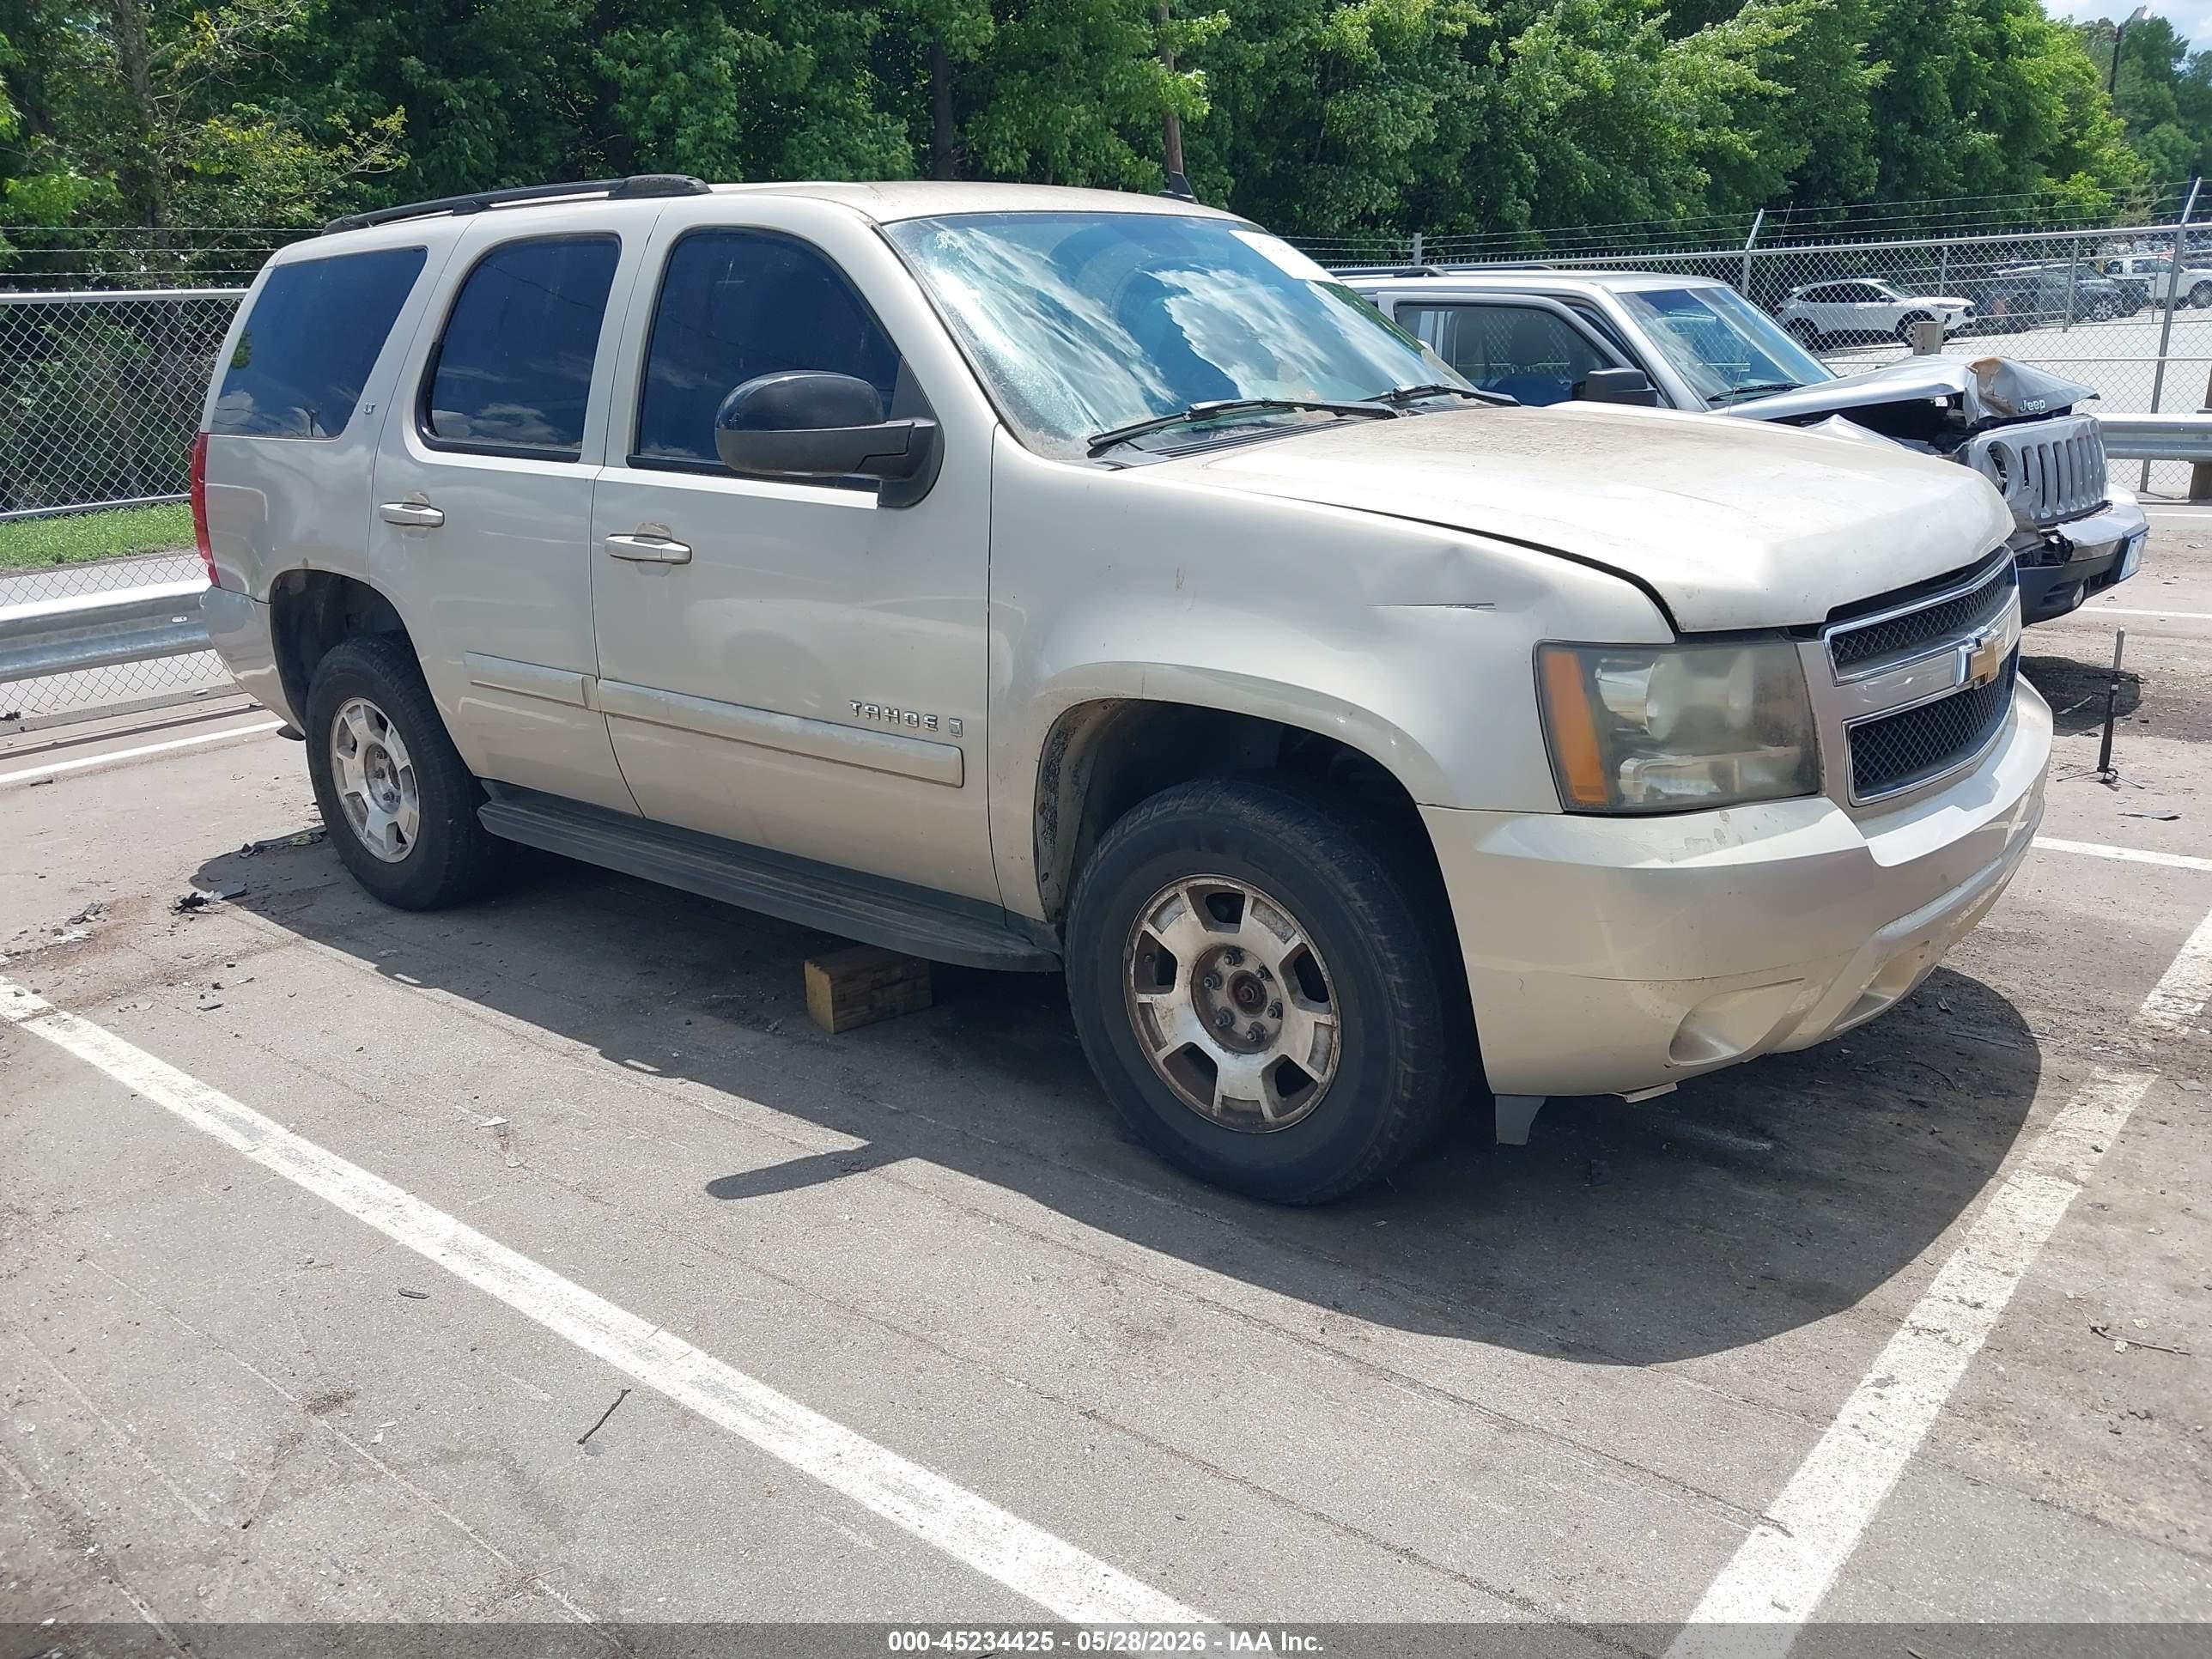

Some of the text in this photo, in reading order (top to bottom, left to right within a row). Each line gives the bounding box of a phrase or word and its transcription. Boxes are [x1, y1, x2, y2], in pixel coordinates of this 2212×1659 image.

[364, 403, 377, 415] LT
[2019, 399, 2045, 412] Jeep
[848, 700, 938, 732] TAHOE
